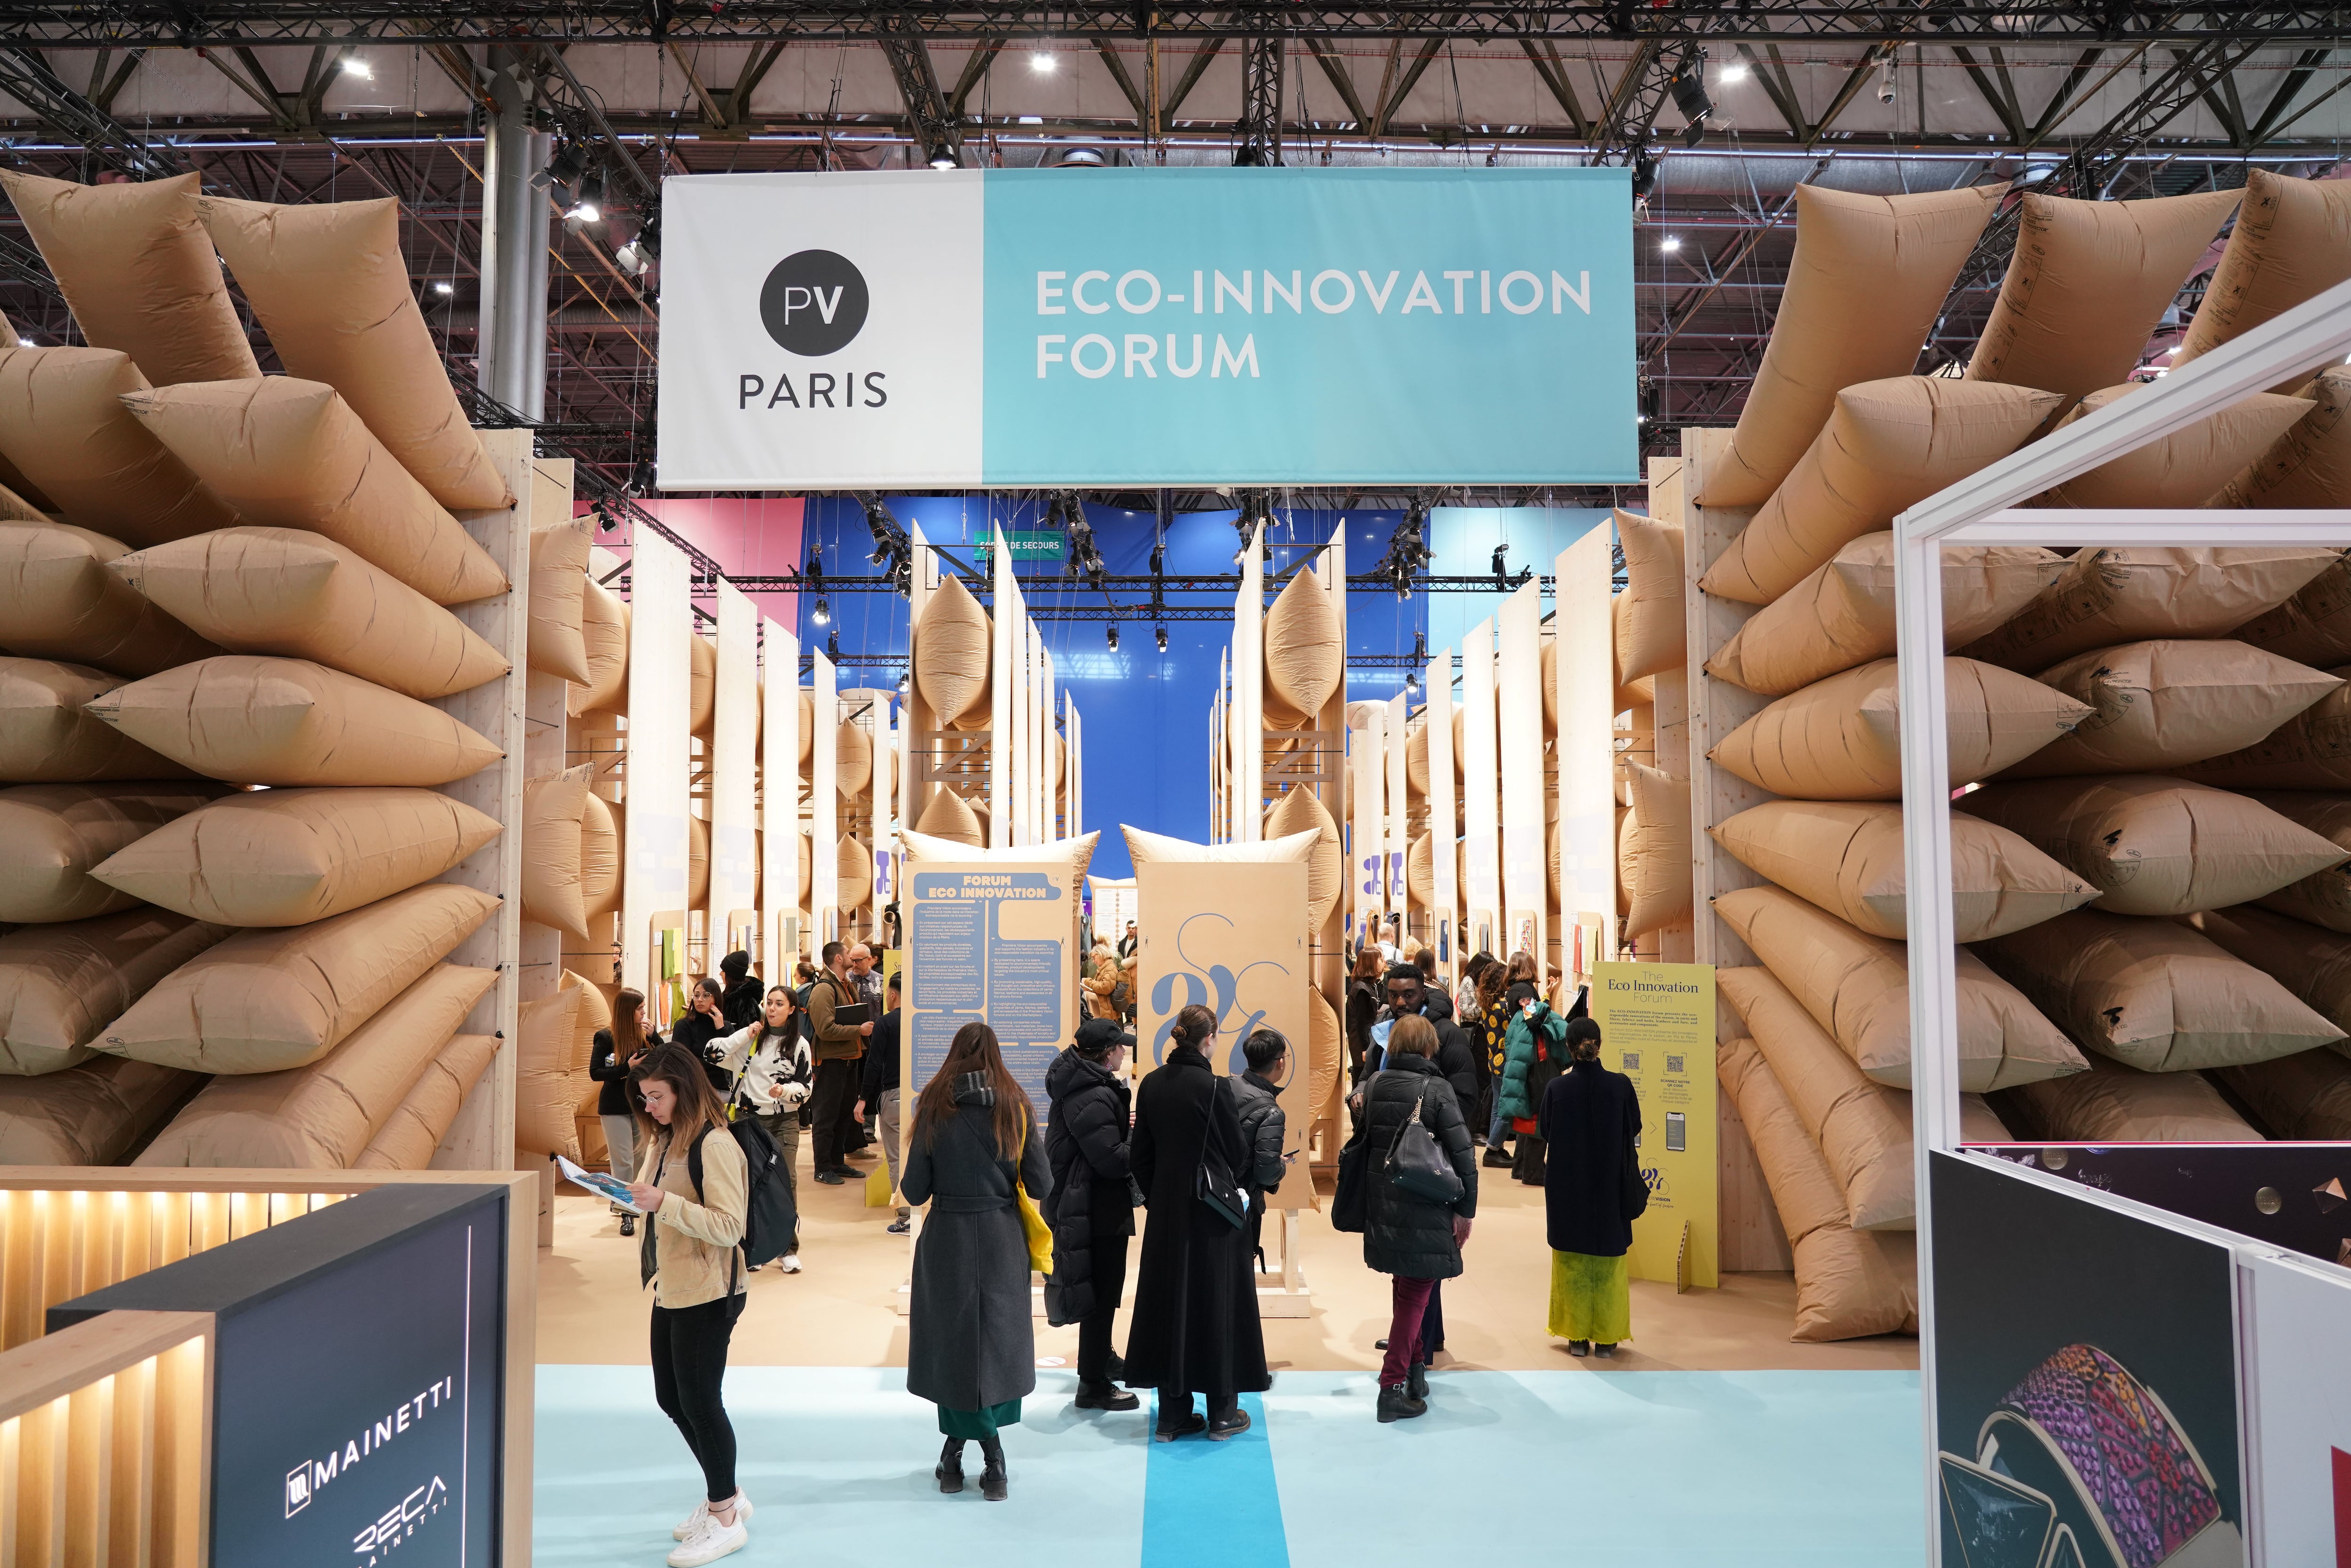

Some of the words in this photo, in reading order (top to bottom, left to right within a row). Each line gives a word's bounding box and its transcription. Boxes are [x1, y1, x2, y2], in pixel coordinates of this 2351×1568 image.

[785, 286, 844, 325] PV
[1036, 270, 1592, 316] ECO-INNOVATION
[1036, 333, 1260, 379] FORUM
[740, 372, 887, 410] PARIS
[929, 888, 956, 898] ECO
[961, 888, 1046, 898] INNOVATION
[963, 876, 1011, 886] FORUM
[1608, 979, 1630, 992] Eco
[1634, 980, 1698, 993] Innovation
[1641, 971, 1663, 982] The
[1633, 992, 1672, 1003] Forum
[315, 1376, 451, 1489] MAINETTI
[358, 1497, 447, 1568] AINETTI
